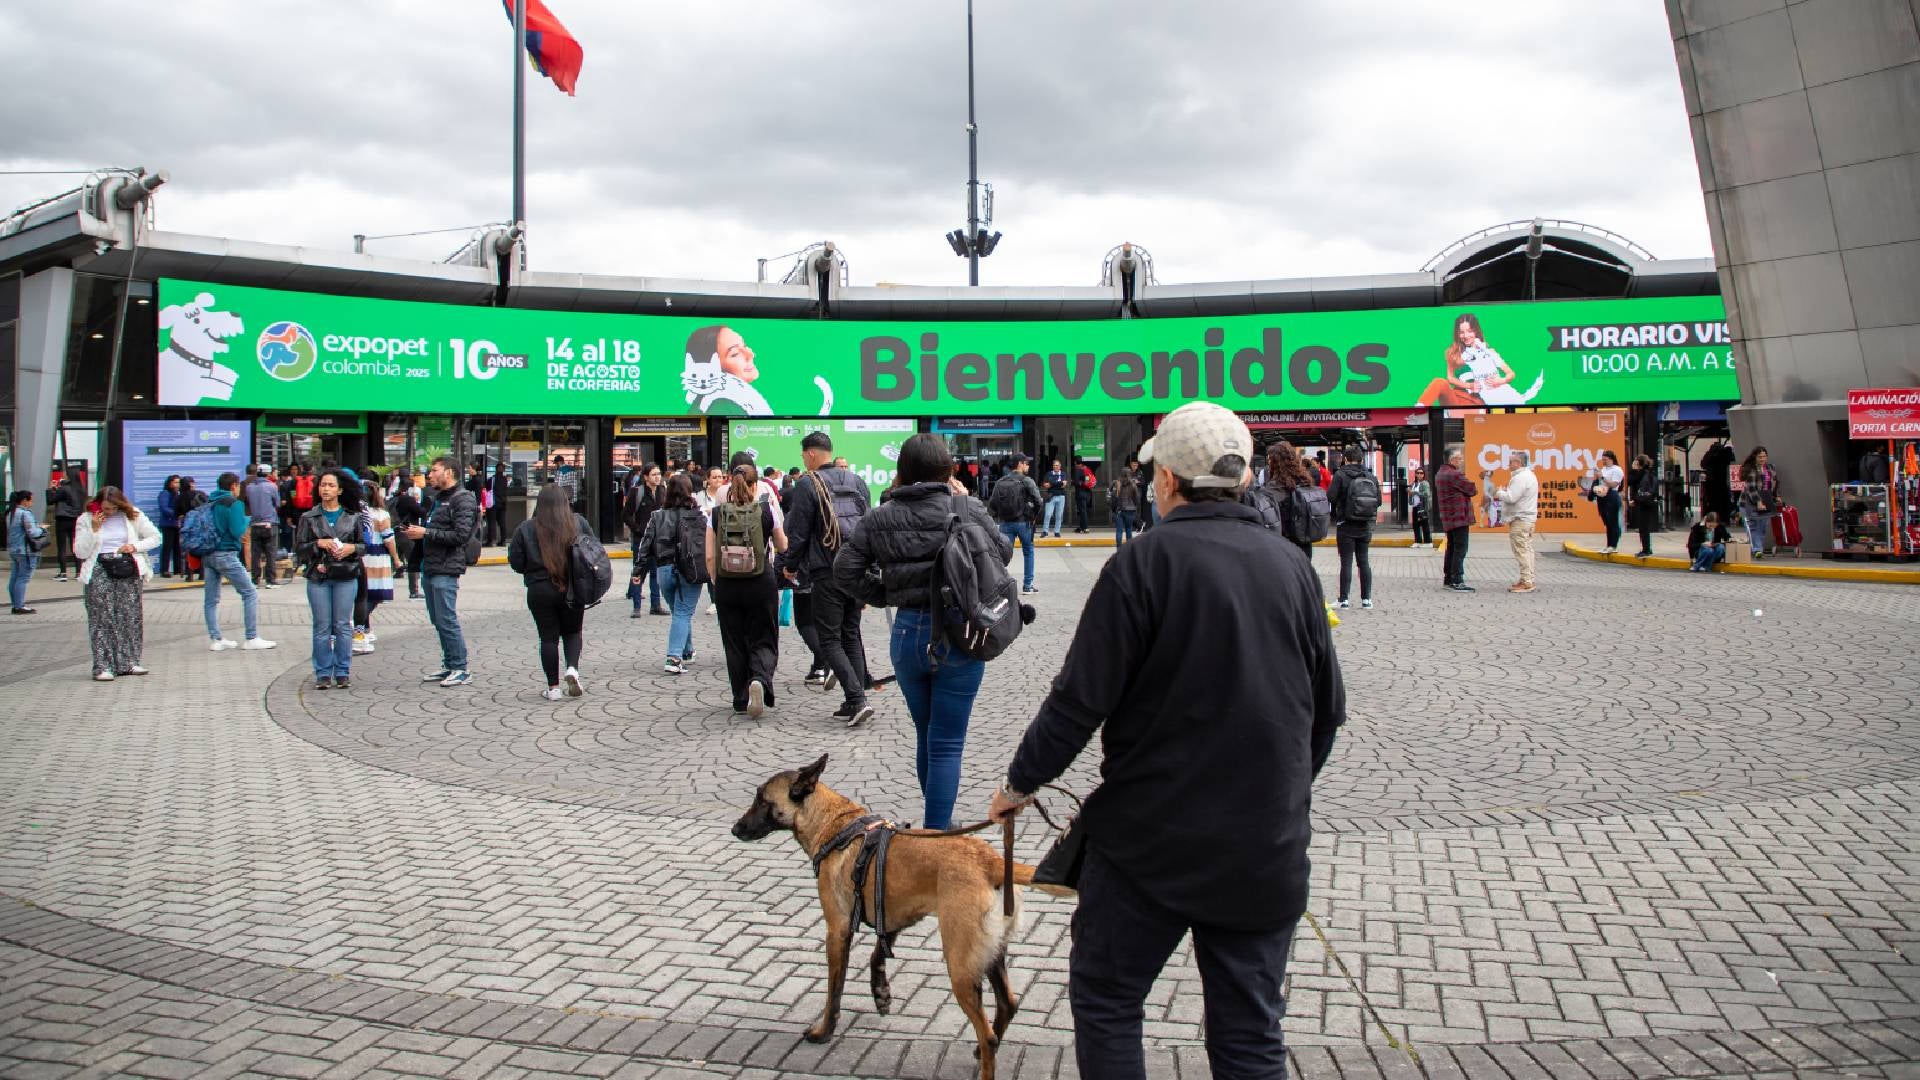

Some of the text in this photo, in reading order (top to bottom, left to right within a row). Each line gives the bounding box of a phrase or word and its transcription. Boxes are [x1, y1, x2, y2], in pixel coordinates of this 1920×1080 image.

[1560, 324, 1689, 348] HORARIO
[322, 334, 430, 361] expopet
[545, 337, 641, 364] 14 al 18
[449, 338, 499, 380] 10
[486, 353, 524, 369] AÑOS
[859, 327, 1391, 401] Bienvenidos
[1581, 353, 1640, 374] 10:00
[1646, 351, 1697, 371] A.M.
[1703, 351, 1720, 370] A
[322, 358, 431, 378] colombia 2025
[546, 363, 641, 379] DE AGOSTO
[547, 378, 641, 392] EN CORFERIAS
[1850, 393, 1920, 405] LAMINACIÓ
[1260, 413, 1295, 422] ONLINE
[1303, 412, 1366, 421] INVITACIONES
[1852, 423, 1887, 434] PORTA
[1542, 480, 1576, 491] eligió
[1545, 509, 1578, 519] bien.
